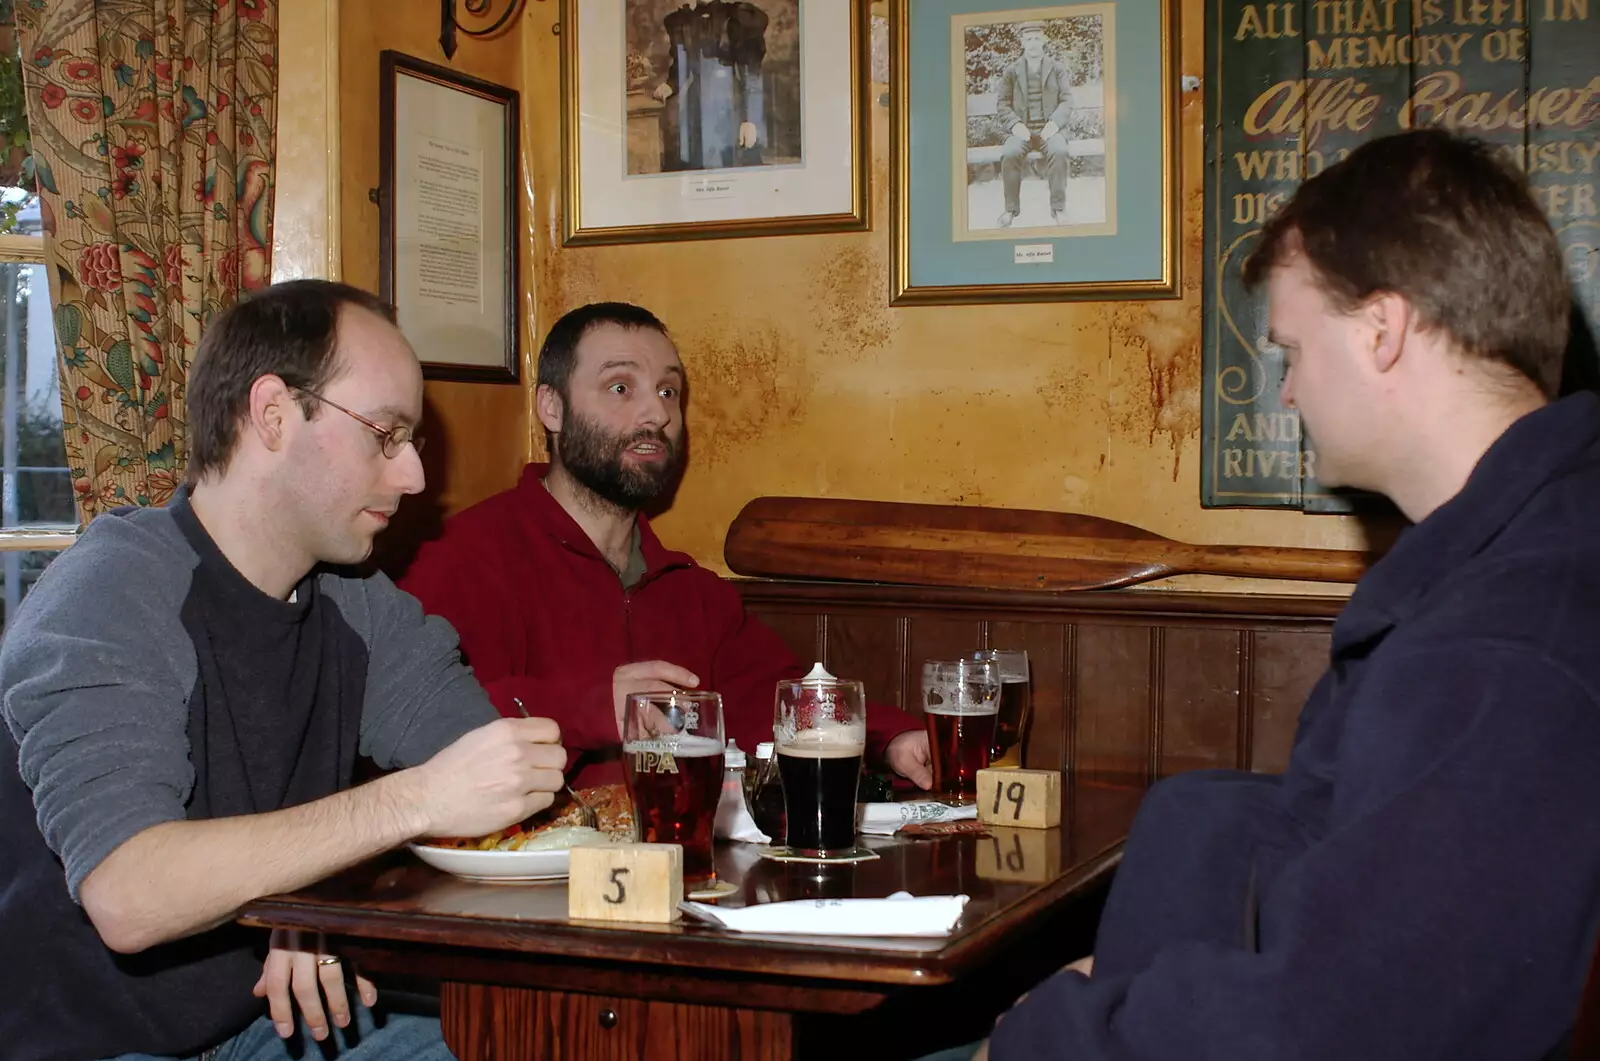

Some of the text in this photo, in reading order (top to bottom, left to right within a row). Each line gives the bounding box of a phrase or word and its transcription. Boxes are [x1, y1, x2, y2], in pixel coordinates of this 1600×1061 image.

[1233, 0, 1589, 41] ALL THAT IS LEFT IN
[1307, 28, 1528, 71] MEMORY OF
[1243, 76, 1381, 150] Alfie
[1233, 148, 1324, 181] WHO
[1224, 412, 1303, 442] AND
[1221, 448, 1316, 478] RIVER
[635, 751, 679, 774] IPA
[993, 781, 1025, 820] 19
[603, 867, 630, 904] 5
